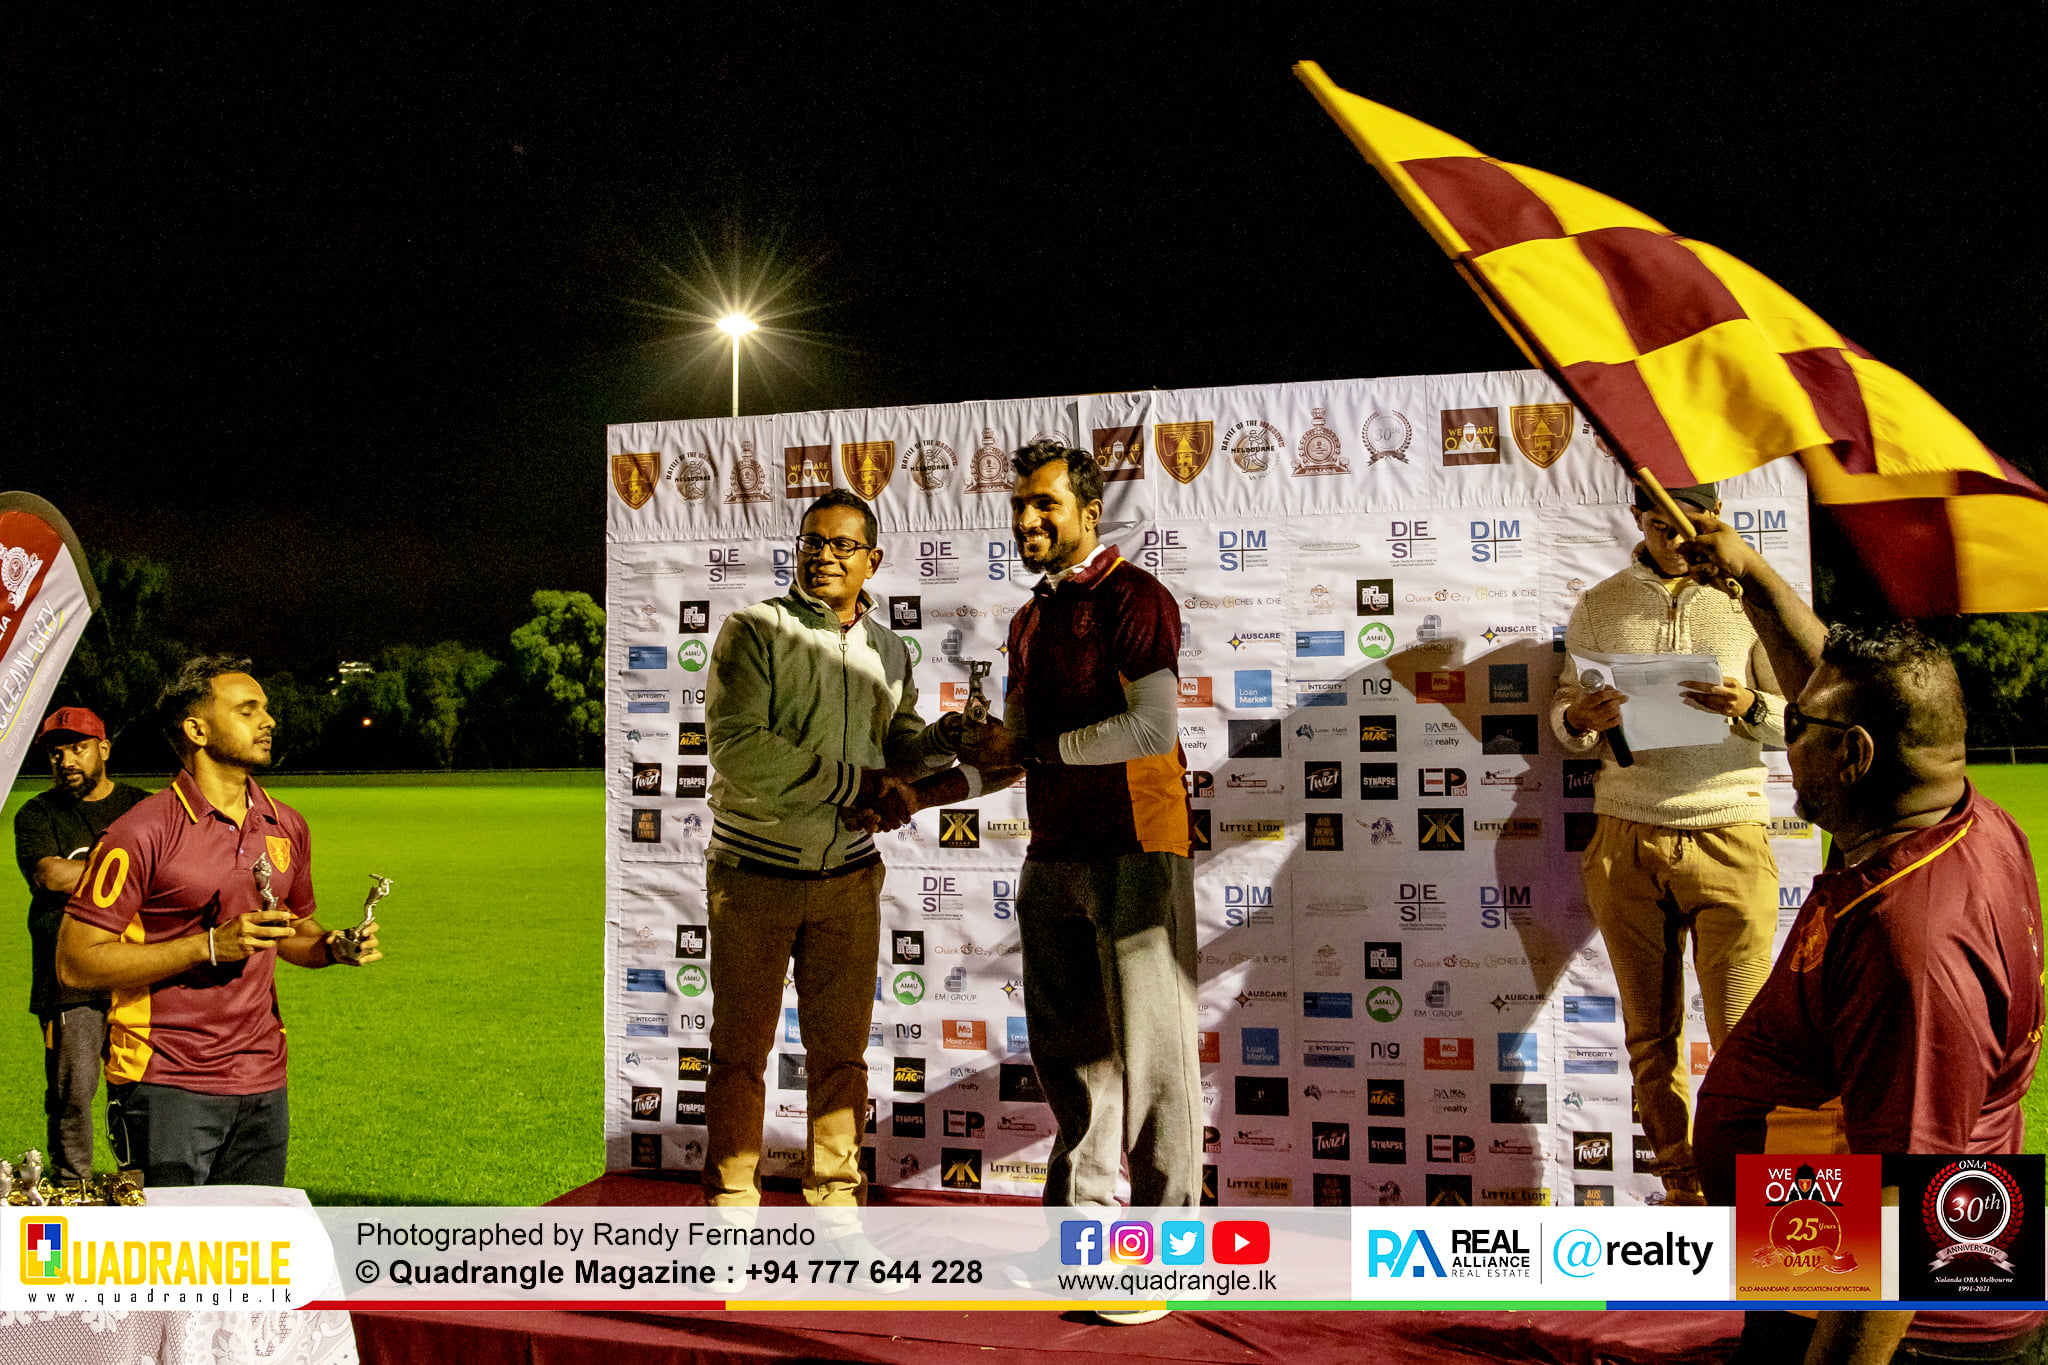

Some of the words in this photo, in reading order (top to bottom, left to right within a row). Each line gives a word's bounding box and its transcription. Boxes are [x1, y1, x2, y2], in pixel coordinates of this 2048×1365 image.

[1221, 427, 1236, 451] BATTLE
[1235, 421, 1244, 430] OF
[1245, 419, 1257, 427] THE
[1260, 420, 1286, 448] MAROONS
[1448, 429, 1463, 437] WE
[1476, 426, 1494, 434] ARE
[1231, 445, 1275, 453] MELBOURNE
[901, 447, 915, 470] BATTLE
[813, 462, 828, 470] ARE
[910, 464, 950, 472] MELBOURNE
[1405, 593, 1433, 603] Quick
[930, 609, 955, 618] Quick
[26, 599, 55, 652] CITY
[1495, 625, 1538, 633] AUSCARE
[1241, 632, 1281, 640] AUSCARE
[932, 656, 943, 664] EM
[1239, 696, 1267, 704] Market
[1184, 740, 1208, 750] realty
[679, 777, 706, 786] SYNAPSE
[1363, 776, 1396, 786] SYNAPSE
[987, 820, 1018, 831] LITTLE
[1219, 821, 1252, 832] LITTLE
[1257, 821, 1280, 832] LION
[1782, 820, 1809, 831] LION
[934, 945, 959, 954] Quick
[1247, 990, 1288, 998] AUSCARE
[1414, 1009, 1427, 1018] EM
[1432, 1009, 1463, 1018] GROUP
[635, 1016, 665, 1024] INTEGRITY
[1315, 1044, 1351, 1052] INTEGRITY
[1576, 1049, 1614, 1058] INTEGRITY
[678, 1103, 706, 1112] SYNAPSE
[1370, 1140, 1404, 1150] SYNAPSE
[1635, 1150, 1656, 1159] SYNA
[990, 1162, 1021, 1173] LITTLE
[1025, 1163, 1047, 1174] LION
[1226, 1178, 1261, 1190] LITTLE
[1264, 1179, 1288, 1190] LION
[1481, 1188, 1517, 1200] LITTLE
[1521, 1190, 1546, 1201] LION
[1586, 1189, 1601, 1199] AUS
